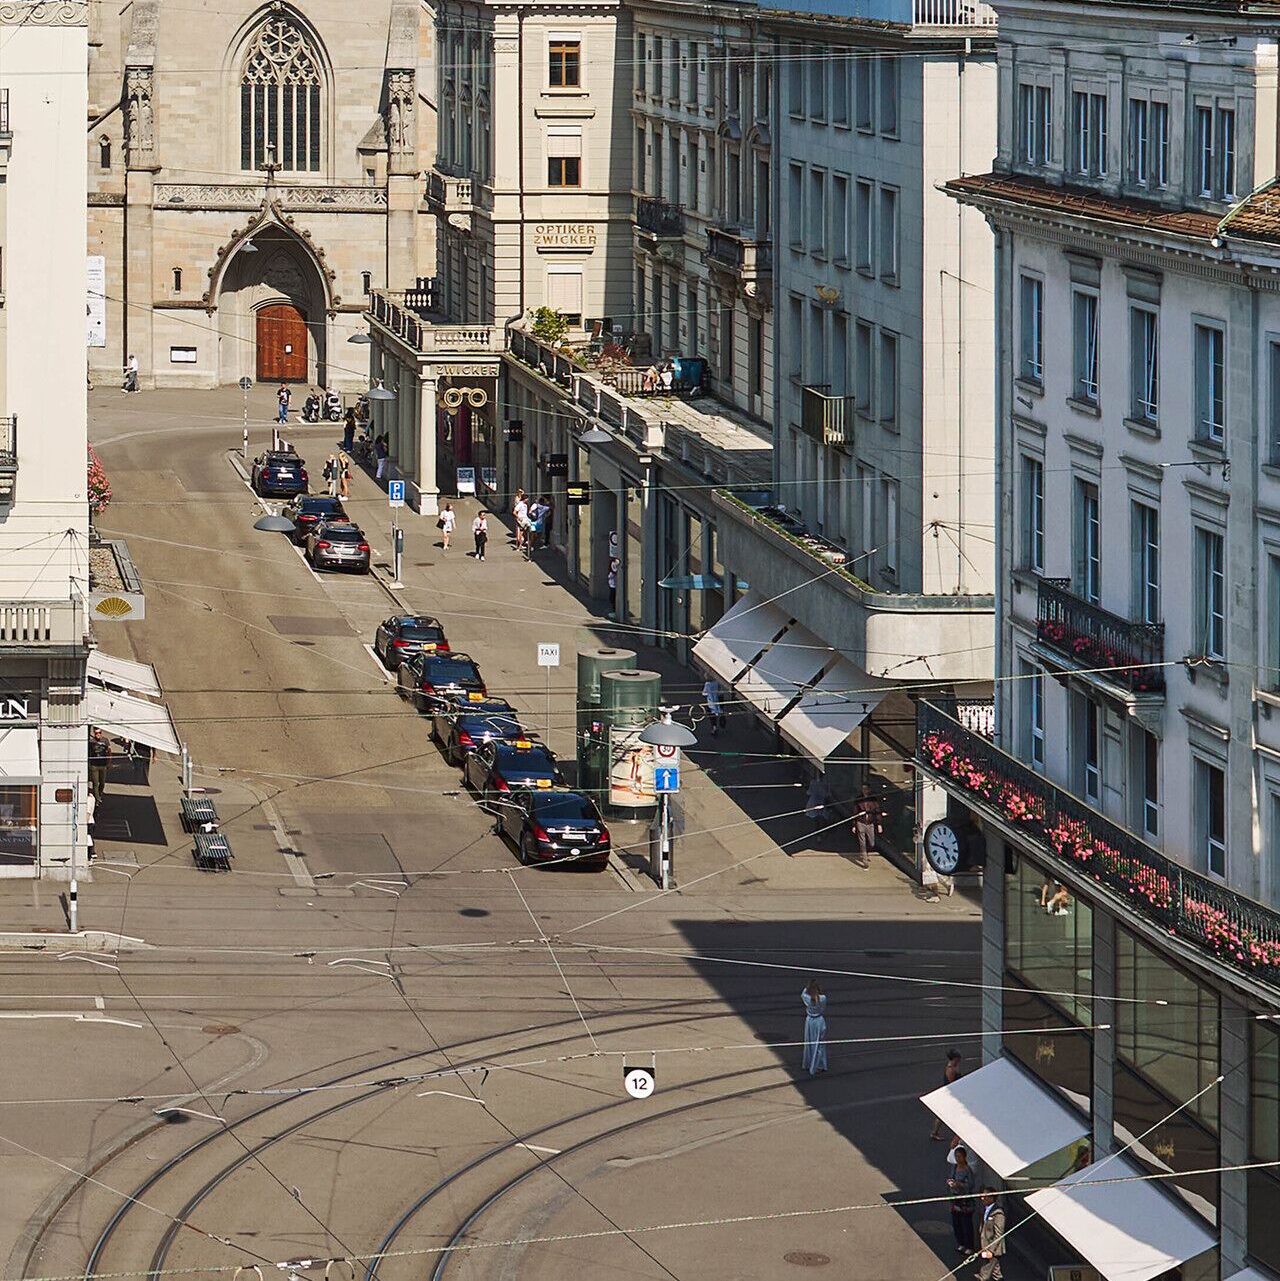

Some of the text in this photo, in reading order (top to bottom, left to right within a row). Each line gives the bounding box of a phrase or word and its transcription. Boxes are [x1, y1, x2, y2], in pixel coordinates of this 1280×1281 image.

[535, 225, 595, 234] OPTIKER
[534, 235, 597, 245] ZWICKER
[436, 365, 498, 376] ZWICKER
[540, 648, 558, 656] TAXI
[632, 1077, 648, 1090] 12
